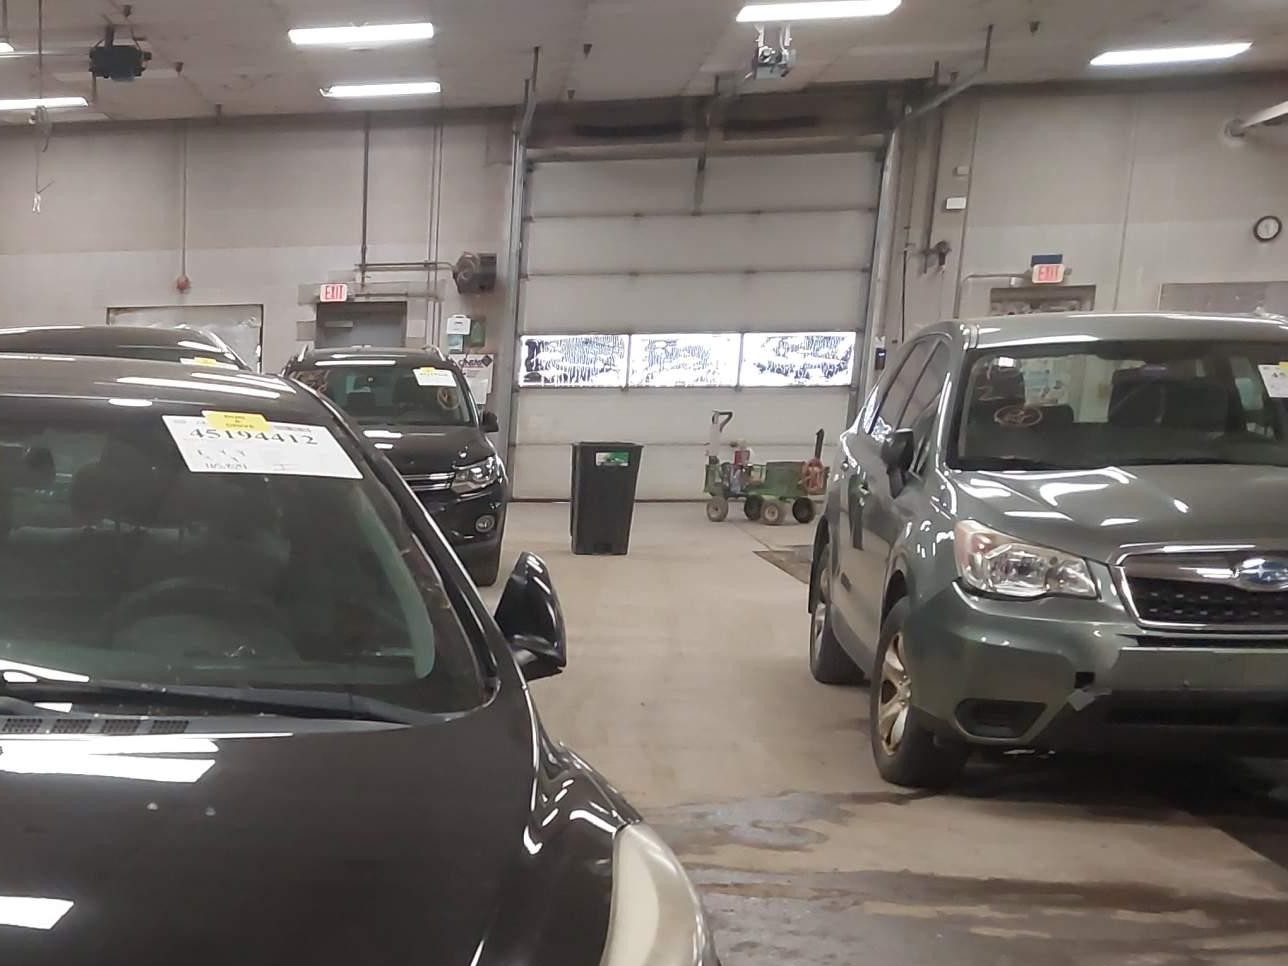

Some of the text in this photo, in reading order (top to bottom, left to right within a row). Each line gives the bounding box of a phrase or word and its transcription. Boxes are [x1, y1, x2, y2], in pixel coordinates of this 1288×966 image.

[1038, 265, 1060, 281] EXIT
[325, 285, 344, 300] EXIT
[190, 428, 318, 446] 45194412
